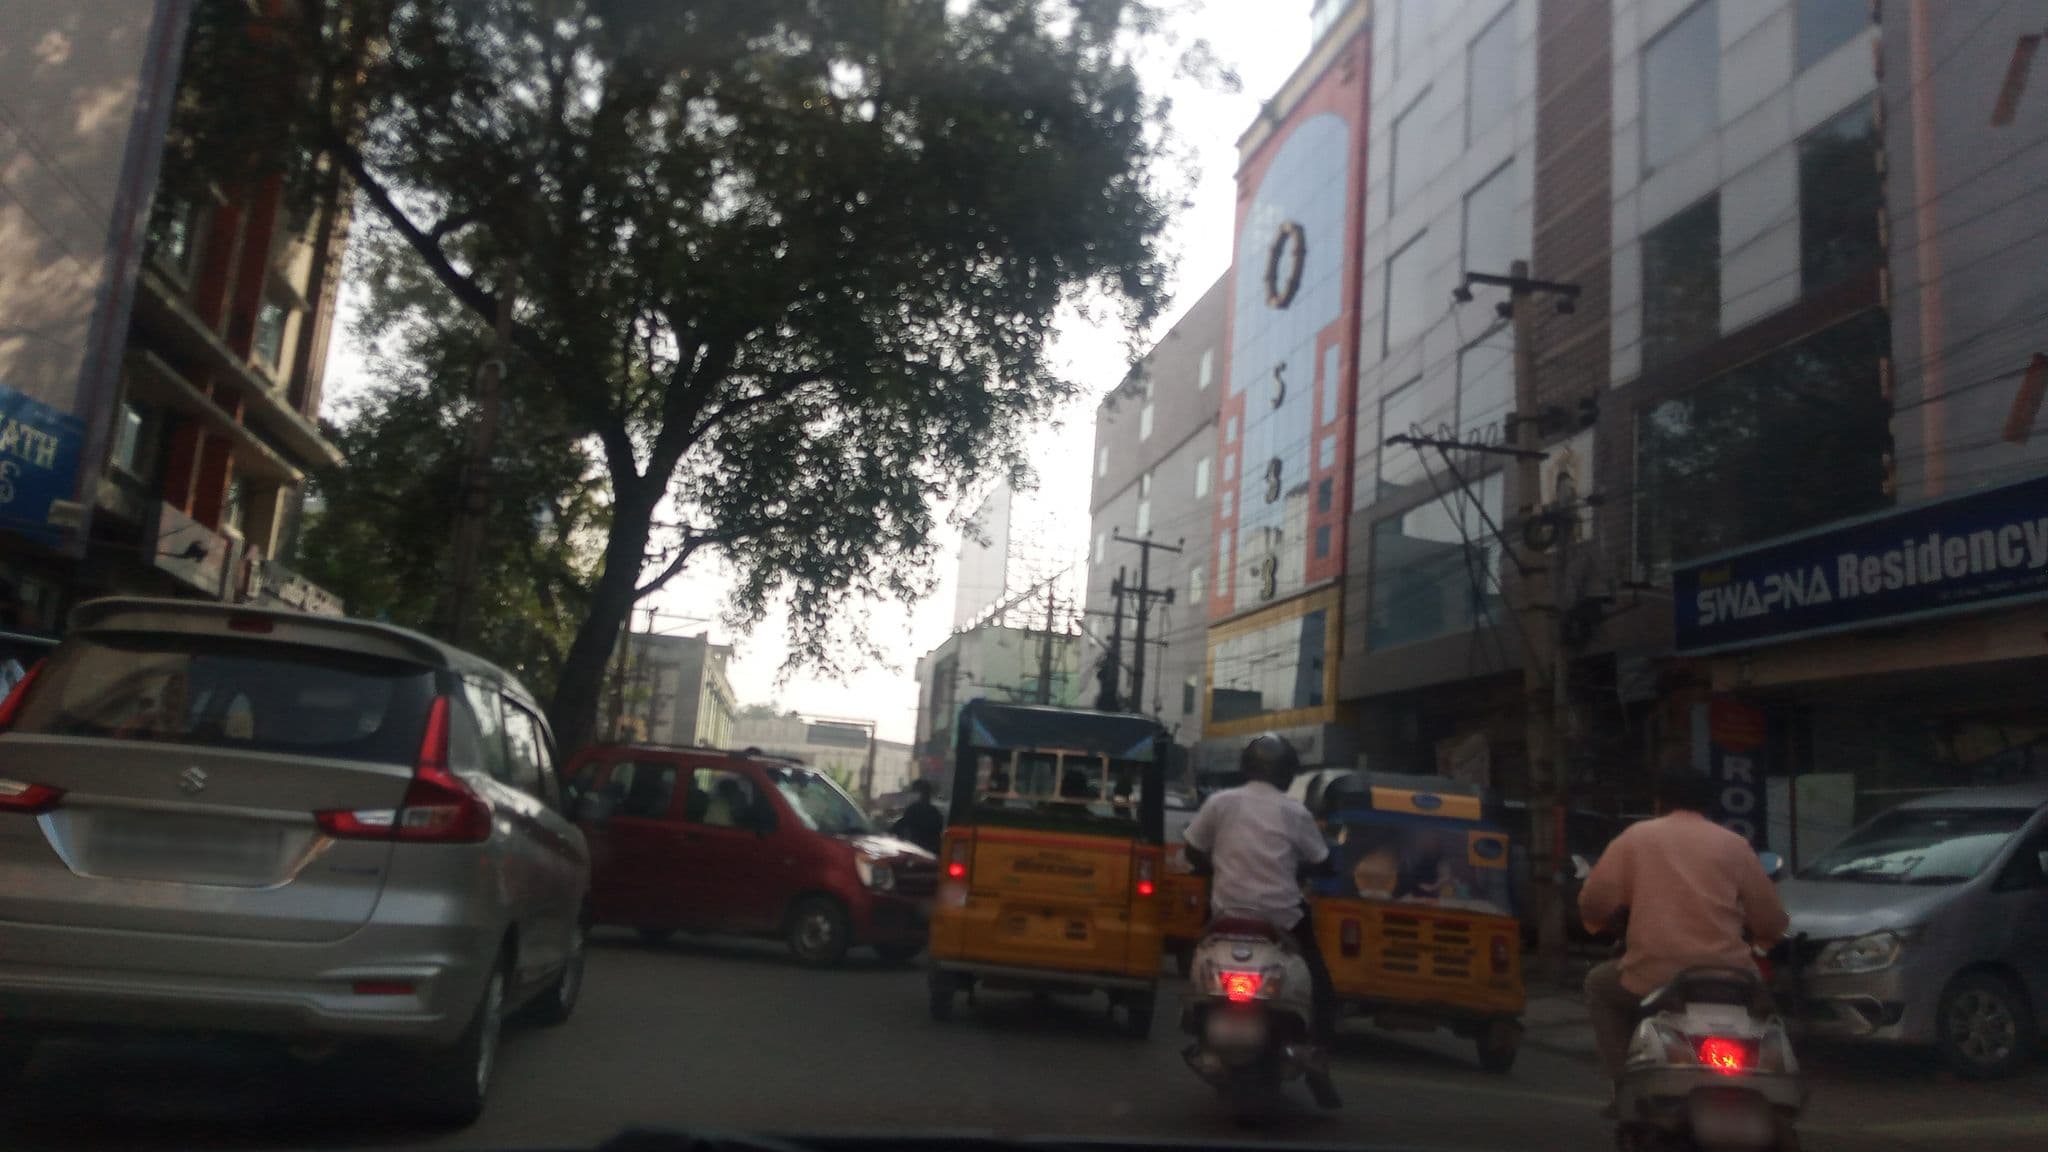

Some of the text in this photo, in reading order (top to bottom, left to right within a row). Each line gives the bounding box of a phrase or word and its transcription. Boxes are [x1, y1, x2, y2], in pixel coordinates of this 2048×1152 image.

[0, 414, 58, 470] ATH
[1696, 565, 1833, 627] SWAPNA
[1837, 516, 2048, 600] Residency
